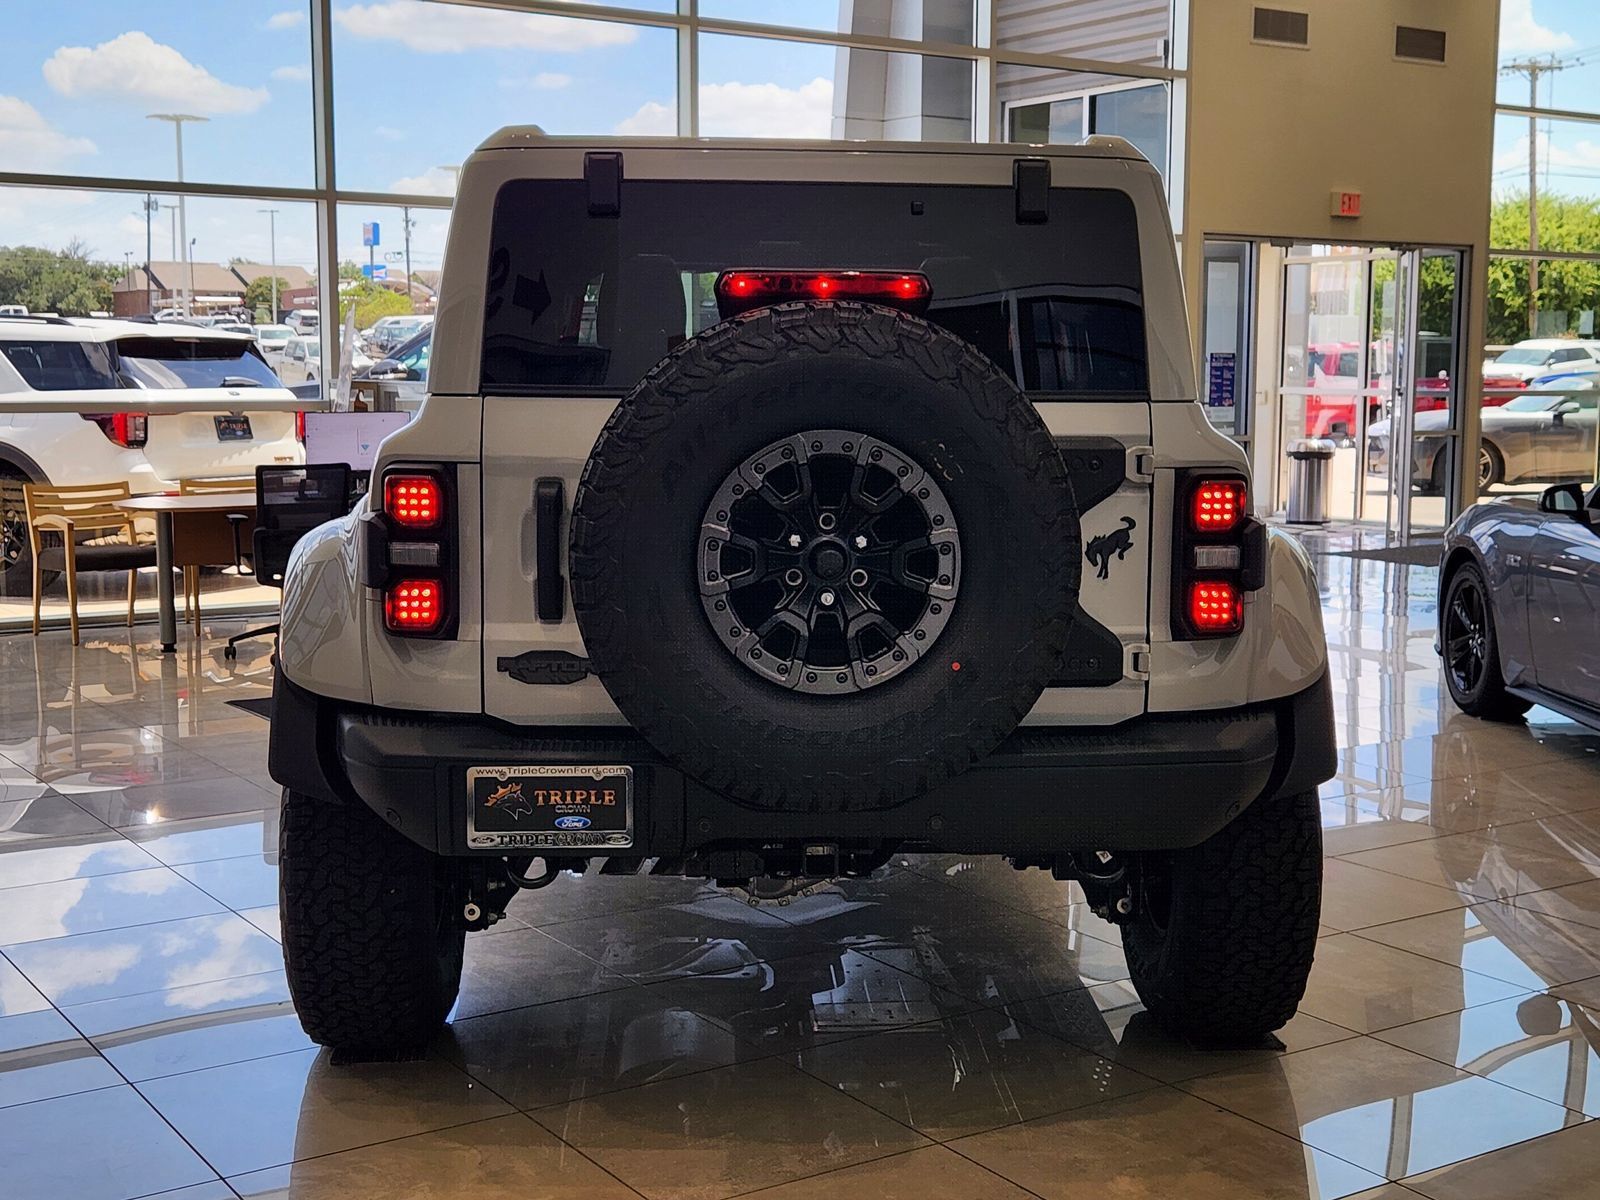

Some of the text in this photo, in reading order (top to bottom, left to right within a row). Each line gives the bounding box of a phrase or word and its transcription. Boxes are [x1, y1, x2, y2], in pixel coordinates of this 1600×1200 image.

[534, 789, 616, 806] TRIPLE
[554, 804, 591, 813] CROWN
[561, 817, 585, 828] Ford
[497, 834, 553, 845] TRIPLE
